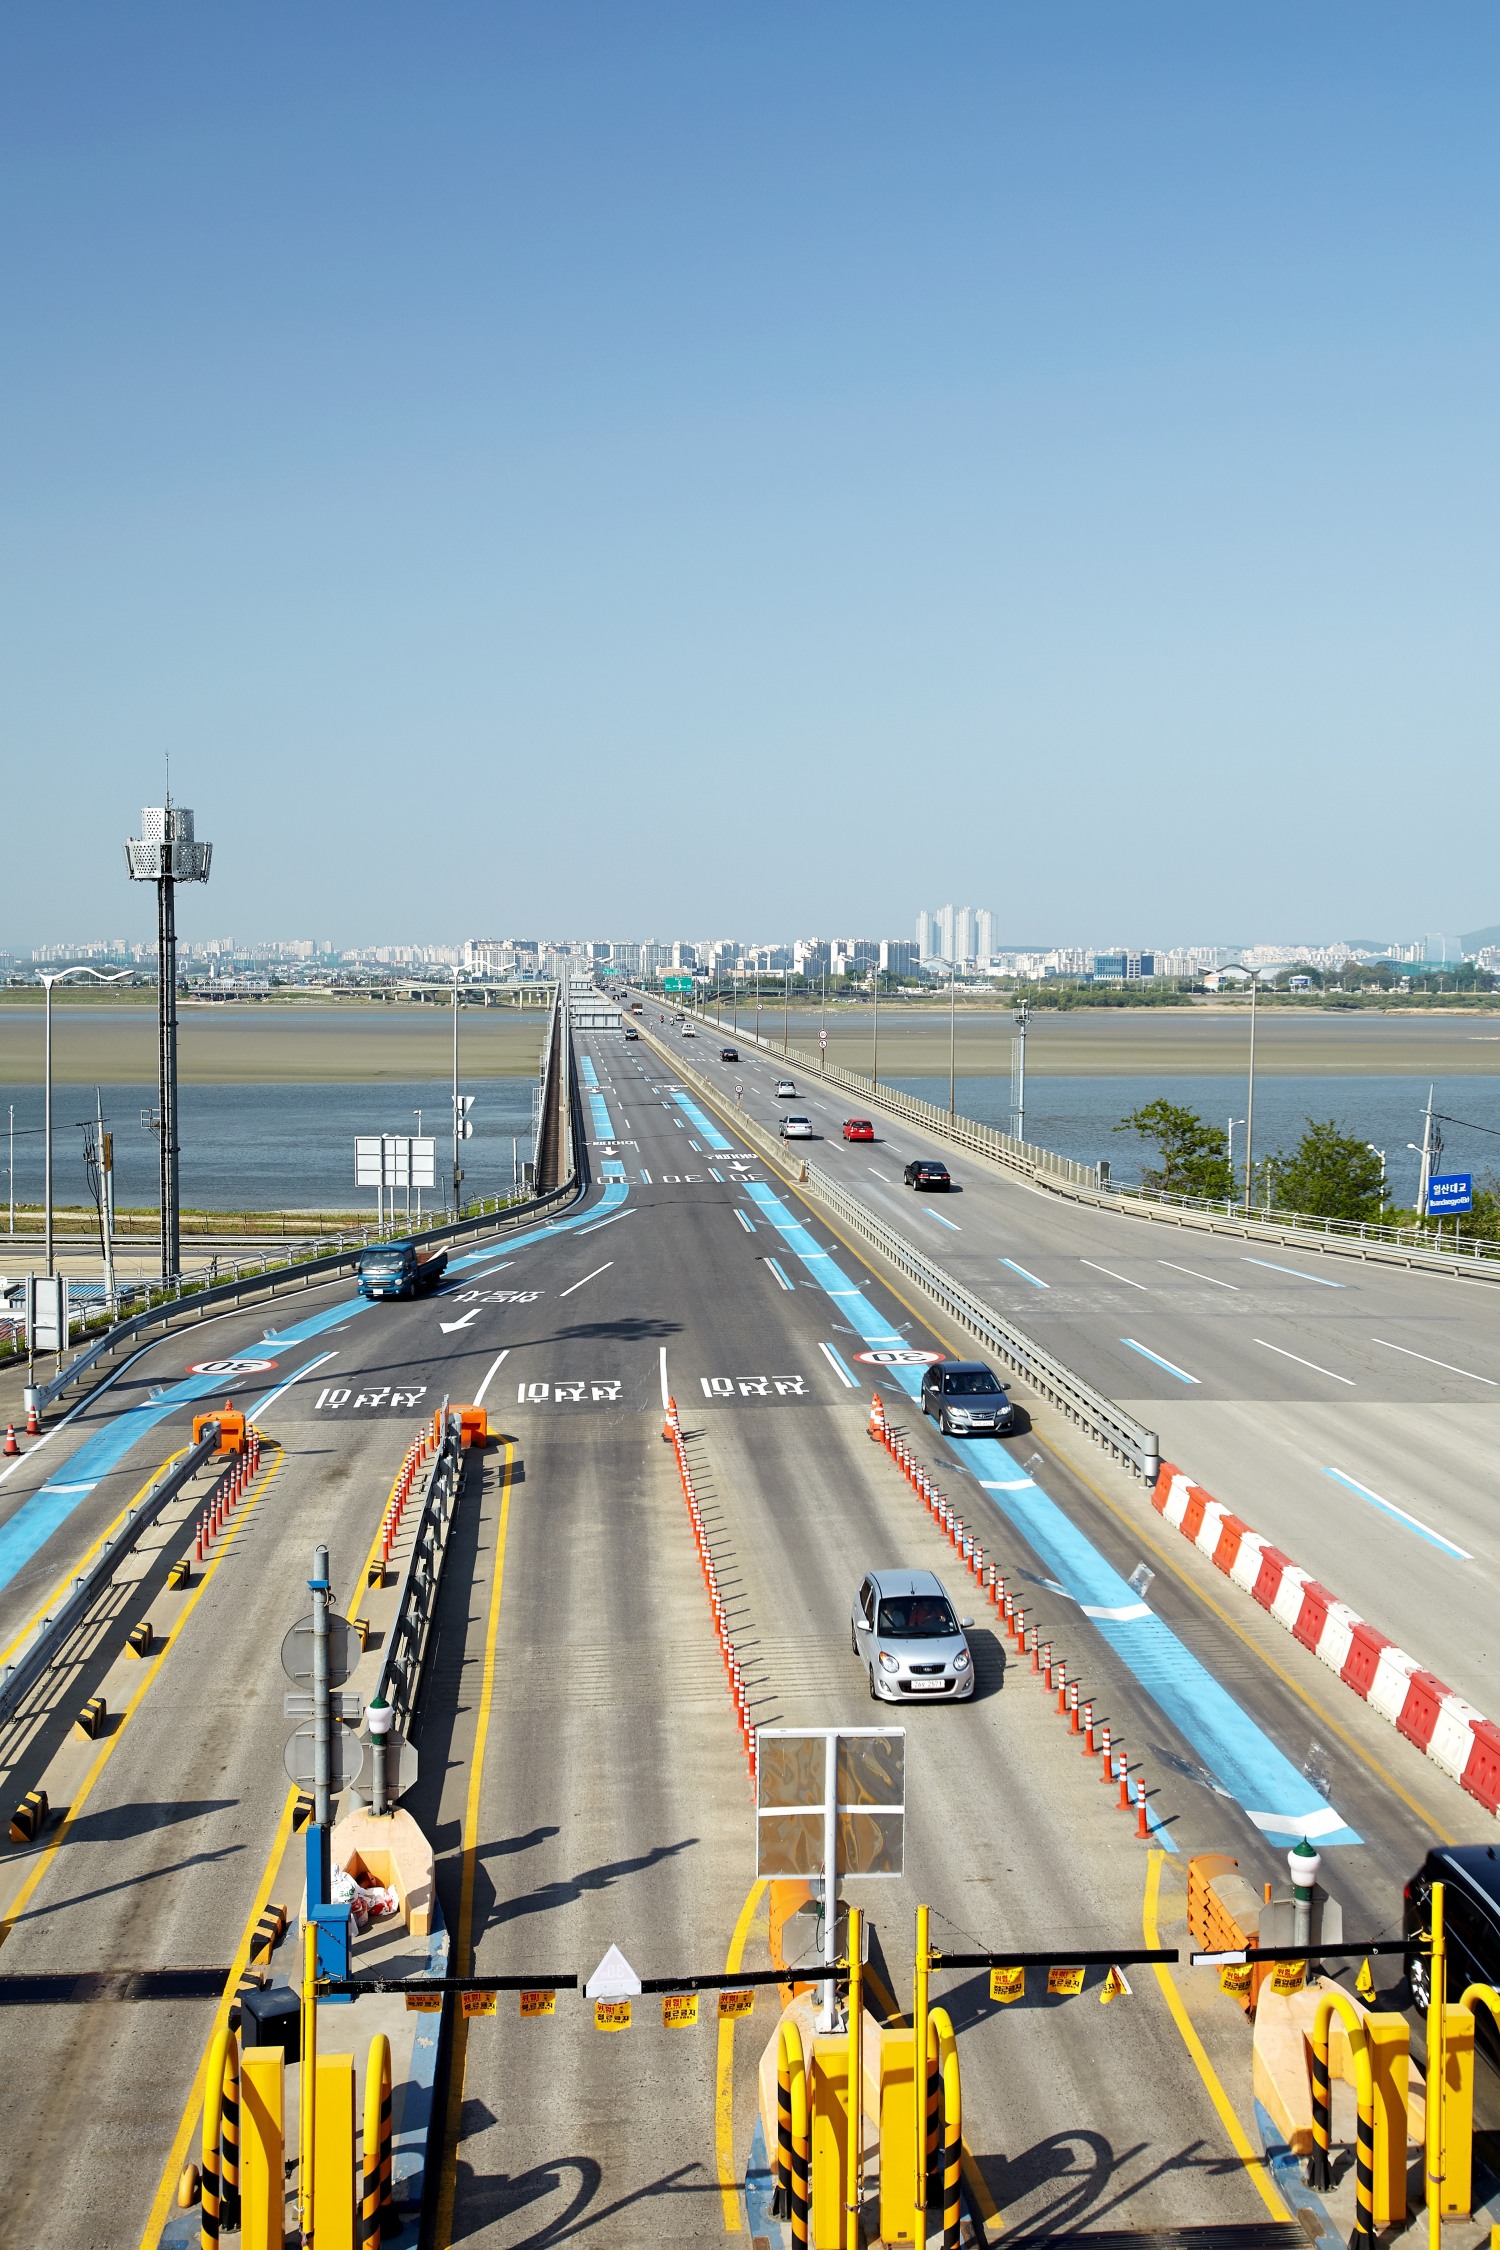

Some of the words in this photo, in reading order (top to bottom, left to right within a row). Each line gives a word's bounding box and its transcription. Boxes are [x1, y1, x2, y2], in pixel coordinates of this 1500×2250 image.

[597, 1176, 637, 1184] 30
[663, 1174, 703, 1183] 30
[729, 1173, 768, 1181] 30
[1433, 1182, 1467, 1196] 일산대교
[451, 1290, 545, 1303] 화물차
[873, 1352, 927, 1361] 30
[202, 1362, 262, 1371] 30
[700, 1375, 809, 1397] 천천히
[517, 1380, 623, 1403] 천천히
[314, 1386, 427, 1409] 천천히
[664, 1998, 682, 2008] 위험!
[664, 2009, 696, 2018] 접근금지
